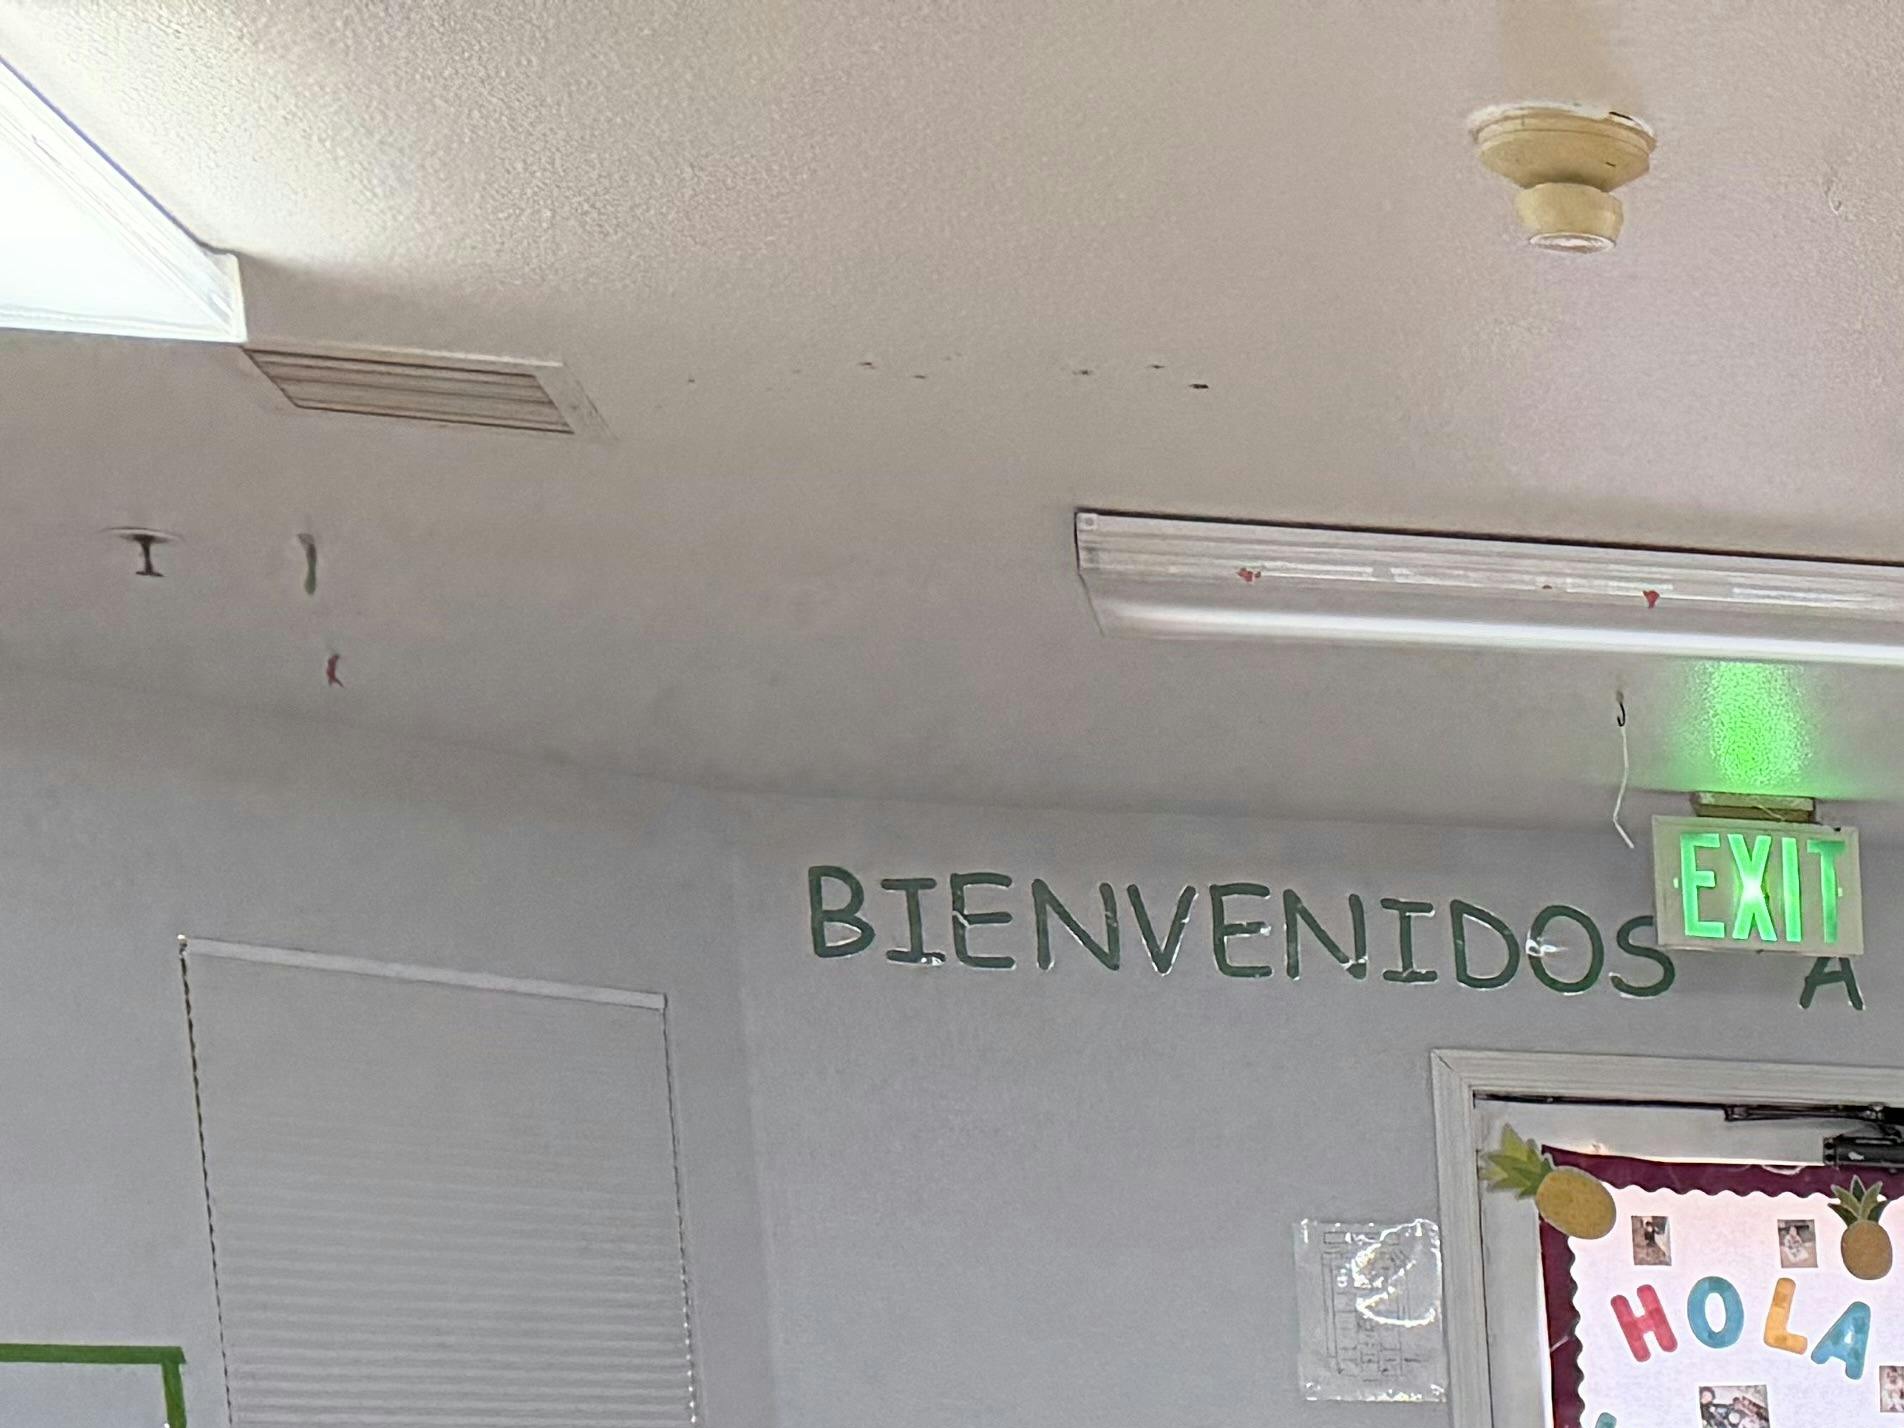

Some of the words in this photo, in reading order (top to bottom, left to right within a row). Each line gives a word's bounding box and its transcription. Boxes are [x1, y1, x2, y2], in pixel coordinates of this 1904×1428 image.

[808, 865, 1676, 997] BIENVENIDOS
[1679, 832, 1847, 943] EXIT
[1610, 1275, 1871, 1380] HOLA
